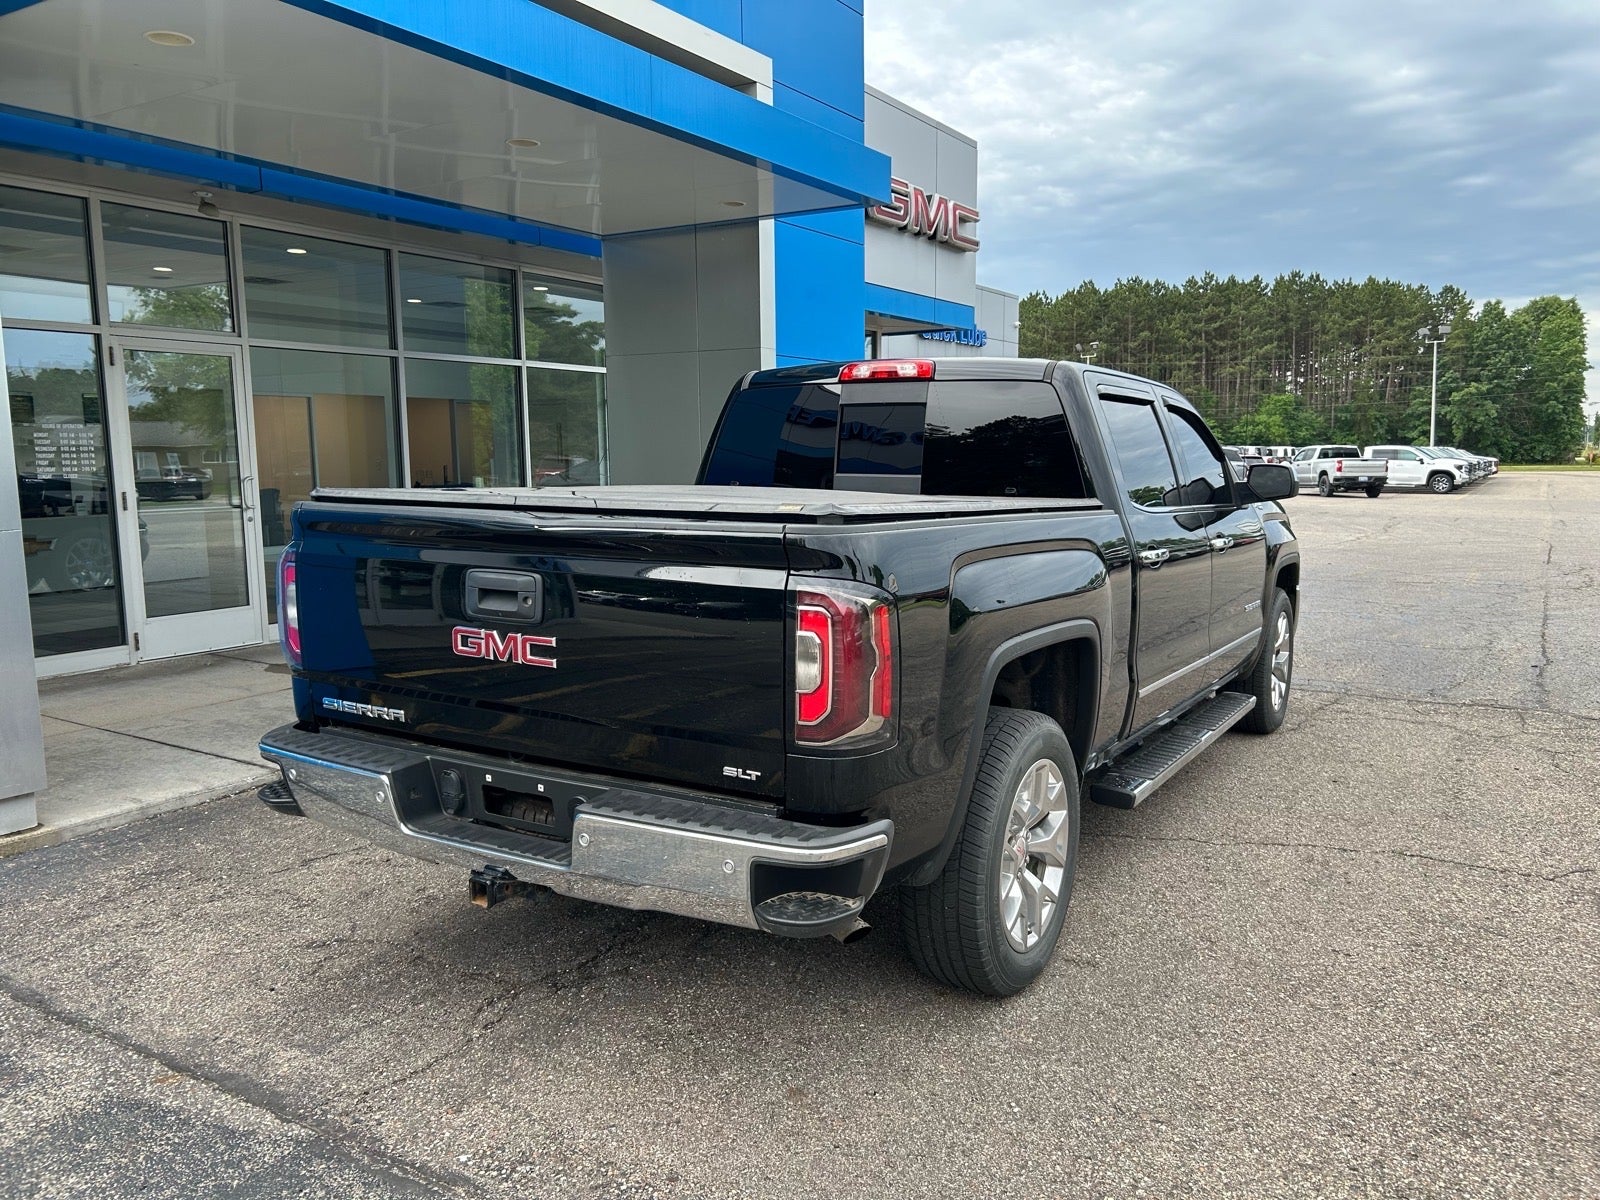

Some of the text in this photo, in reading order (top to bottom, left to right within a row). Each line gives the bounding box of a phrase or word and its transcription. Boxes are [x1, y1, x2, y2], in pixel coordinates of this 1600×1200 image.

[866, 176, 980, 252] GMC
[452, 626, 557, 668] GMC
[322, 697, 405, 723] SIERRA
[723, 766, 761, 780] SLT
